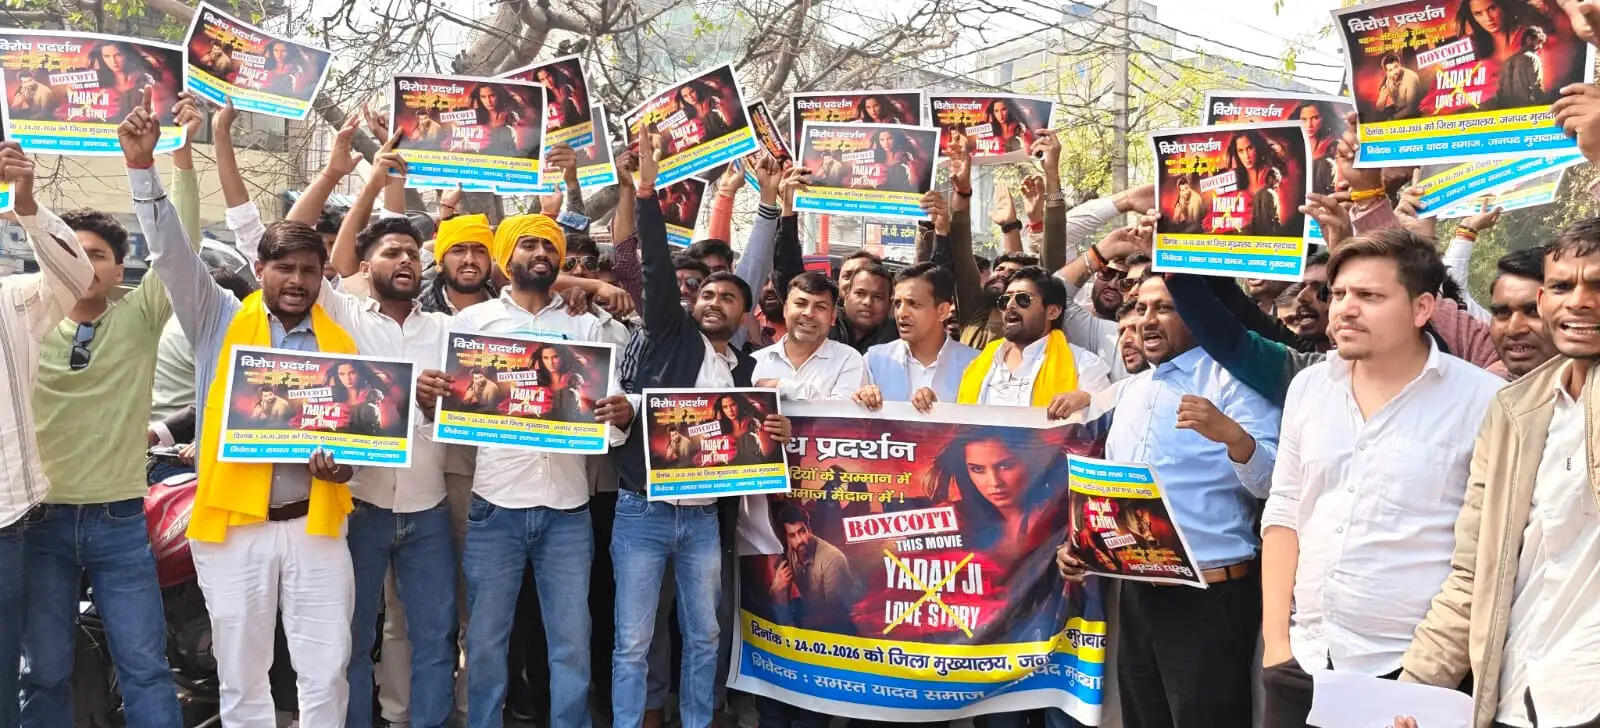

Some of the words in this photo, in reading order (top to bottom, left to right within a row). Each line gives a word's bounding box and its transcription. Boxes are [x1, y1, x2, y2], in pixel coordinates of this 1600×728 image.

[1348, 17, 1389, 34] विरोध
[1394, 6, 1445, 27] प्रदर्शन
[1418, 40, 1471, 65] BOYCOTT
[399, 81, 427, 93] विरोध
[430, 84, 464, 94] प्रदर्शन
[1213, 102, 1242, 116] विरोध
[1244, 104, 1283, 118] प्रदर्शन
[1159, 141, 1186, 155] विरोध
[1189, 137, 1221, 154] प्रदर्शन
[454, 337, 485, 351] विरोध
[489, 343, 526, 354] प्रदर्शन
[241, 356, 275, 369] विरोध
[280, 360, 320, 372] प्रदर्शन
[650, 398, 675, 408] विरोध
[679, 397, 708, 408] प्रदर्शन
[816, 433, 918, 463] प्रदर्शन
[820, 468, 836, 481] के
[839, 471, 892, 484] सम्मान
[896, 471, 913, 485] में
[831, 486, 874, 503] मैदान
[878, 490, 895, 504] में
[849, 510, 953, 538] BOYCOTT
[896, 537, 925, 552] THIS
[925, 535, 964, 549] MOVIE
[884, 557, 958, 593] YADAV
[962, 562, 984, 596] JI
[885, 600, 923, 628] LOVE
[751, 620, 784, 647] दिनांक
[794, 640, 861, 661] 24.02.2026
[864, 646, 885, 665] को
[888, 647, 930, 670] जिला
[933, 656, 1012, 677] मुख्यालय,
[752, 652, 799, 681] निवेदक
[813, 675, 867, 696] समस्त
[872, 684, 919, 701] यादव
